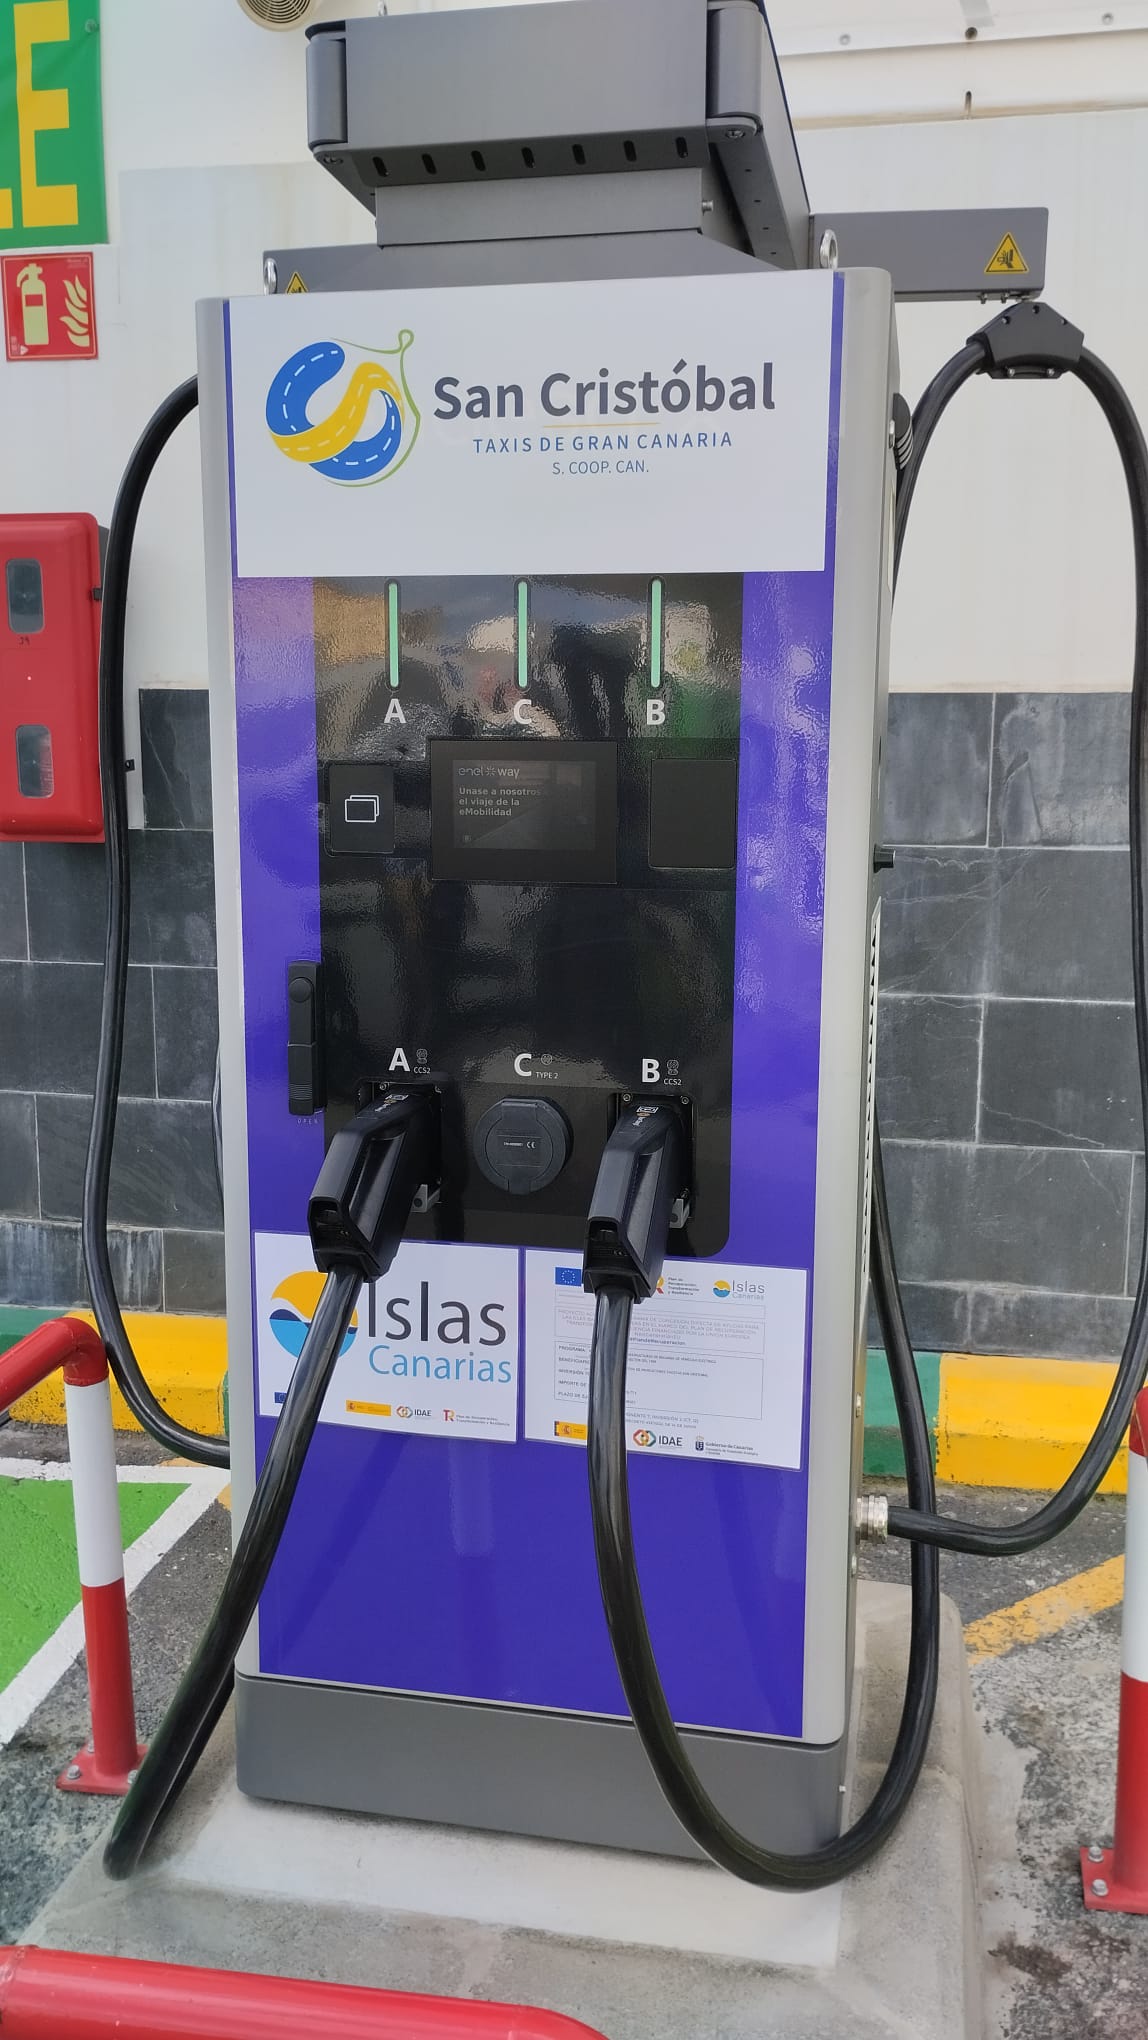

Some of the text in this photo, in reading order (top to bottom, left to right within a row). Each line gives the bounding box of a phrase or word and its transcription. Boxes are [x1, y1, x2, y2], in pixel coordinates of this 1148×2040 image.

[0, 0, 78, 229] E
[433, 358, 776, 420] San Cristóbal
[473, 431, 733, 454] TAXIS DE GRAN CANARIA
[552, 458, 650, 476] S. COOP. CAN.
[384, 699, 407, 724] A
[513, 699, 533, 725] C
[646, 699, 666, 725] B
[497, 768, 520, 780] way
[459, 787, 489, 796] Unase
[500, 787, 541, 797] nosotros
[459, 798, 520, 808] el viaje de la
[459, 808, 513, 817] eMobilidad
[388, 1047, 411, 1073] A
[413, 1065, 431, 1075] CCS2
[514, 1053, 532, 1077] C
[535, 1071, 559, 1080] TYPE 2
[641, 1058, 660, 1083] B
[663, 1077, 682, 1087] CCS2
[732, 1280, 765, 1294] Islas
[368, 1281, 507, 1346] Islas
[369, 1345, 512, 1383] Canarias
[414, 1408, 432, 1417] IDAE
[659, 1435, 683, 1447] IDAE
